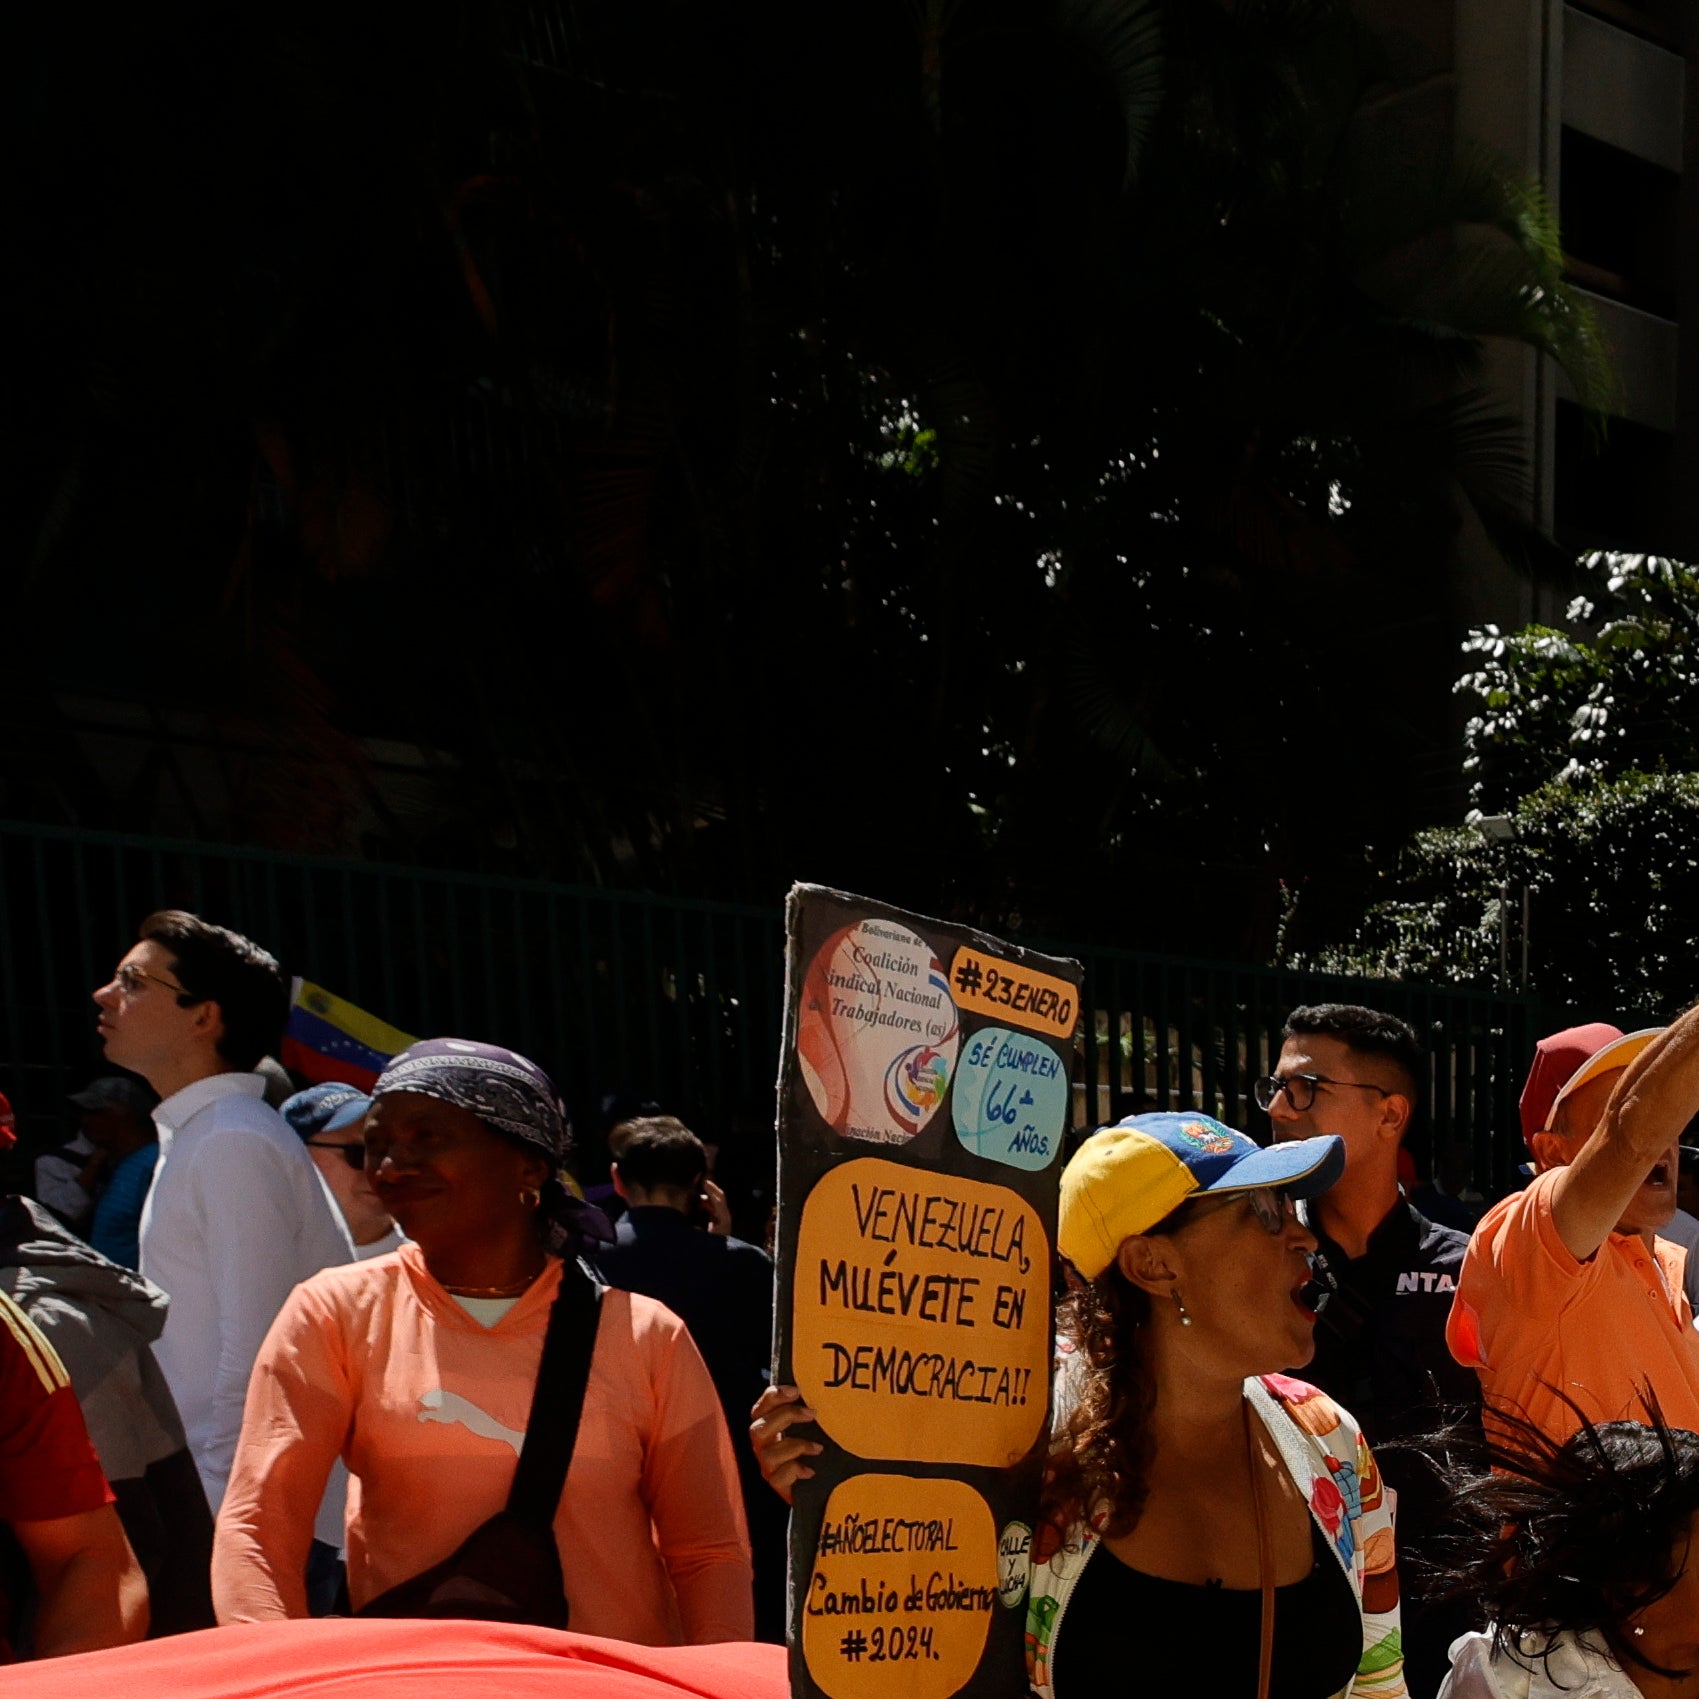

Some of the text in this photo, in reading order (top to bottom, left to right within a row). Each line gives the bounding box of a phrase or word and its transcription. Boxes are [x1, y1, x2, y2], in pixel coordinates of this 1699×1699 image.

[852, 946, 918, 977] Coalición
[884, 979, 942, 1010] Nacional
[955, 957, 1071, 1026] #23ENERO
[832, 997, 922, 1033] Trabajadores
[926, 1018, 947, 1039] (as)
[968, 1035, 1060, 1081] SÉ CUMPLEN
[1007, 1124, 1050, 1156] AÑOS.
[851, 1183, 1031, 1275] VENEZUELA,
[819, 1249, 1027, 1330] MUÉVETE EN
[821, 1341, 1032, 1407] DEMOCRACIA!!
[819, 1512, 958, 1558] #AÑOELECTORAL
[807, 1572, 899, 1616] Cambio
[903, 1573, 924, 1612] de
[839, 1625, 940, 1663] #2024.
